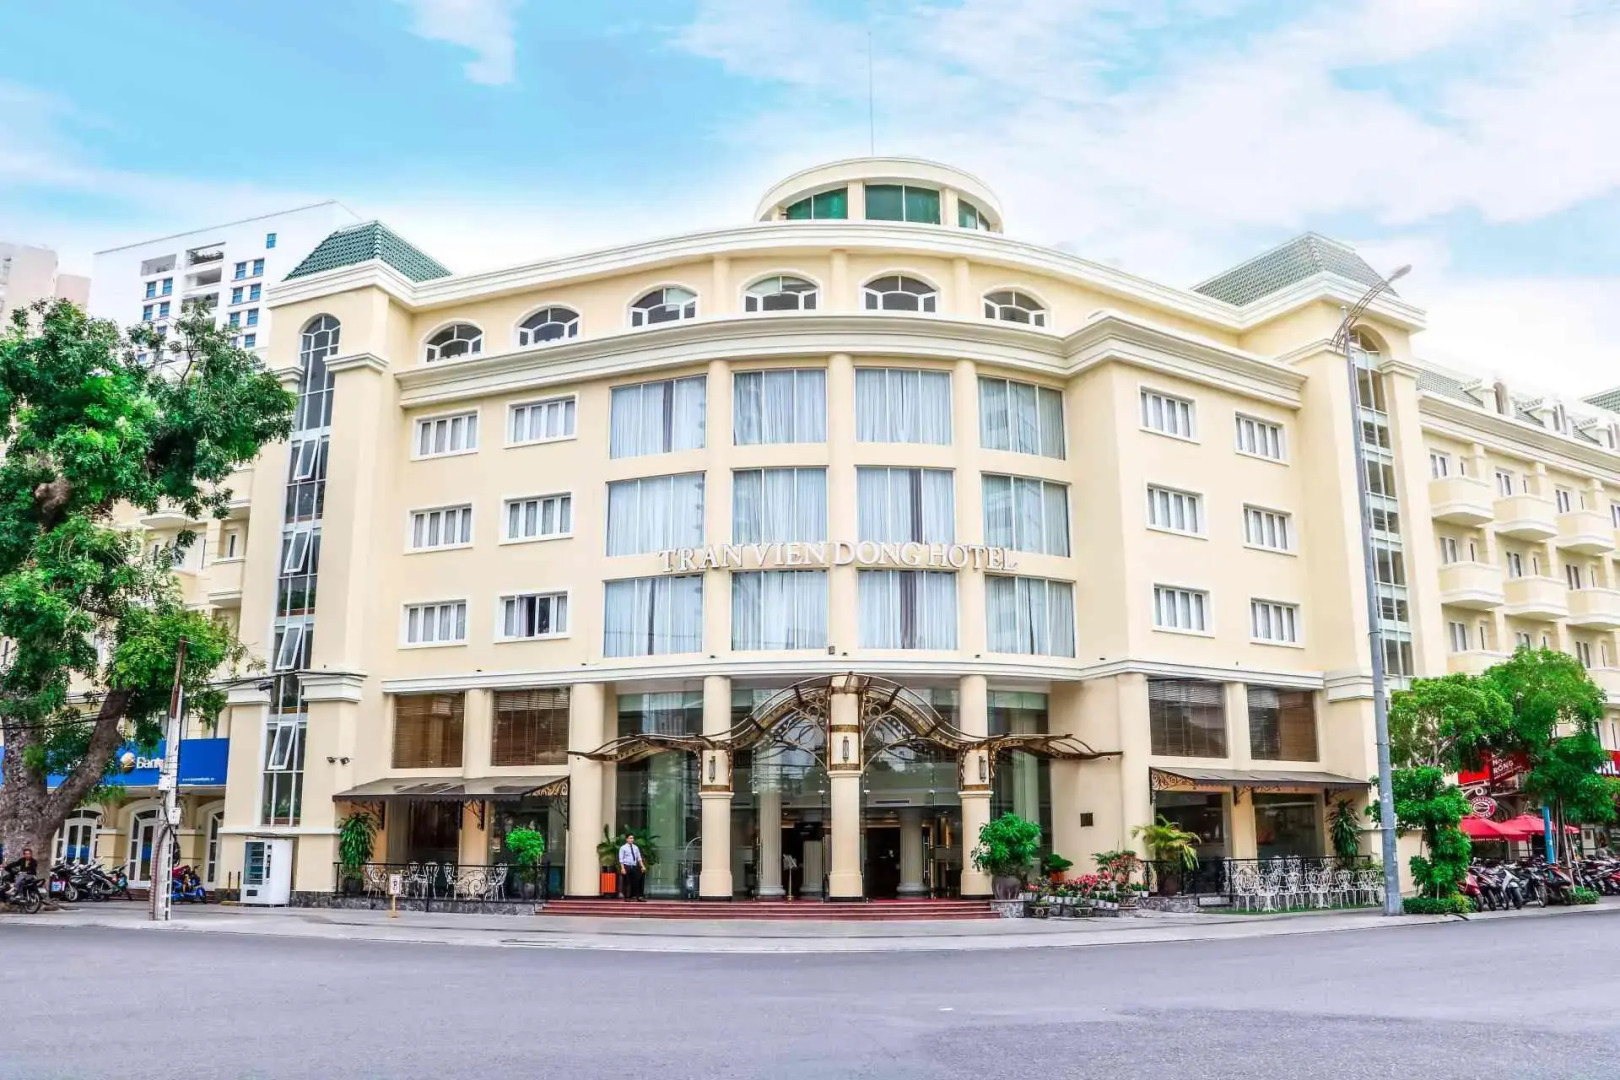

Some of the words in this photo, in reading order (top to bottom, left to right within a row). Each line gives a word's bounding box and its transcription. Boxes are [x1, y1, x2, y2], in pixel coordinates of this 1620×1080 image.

[659, 544, 745, 573] TRAN
[751, 542, 832, 567] VIEN
[832, 540, 920, 567] DONG
[927, 543, 1017, 571] HOTEL
